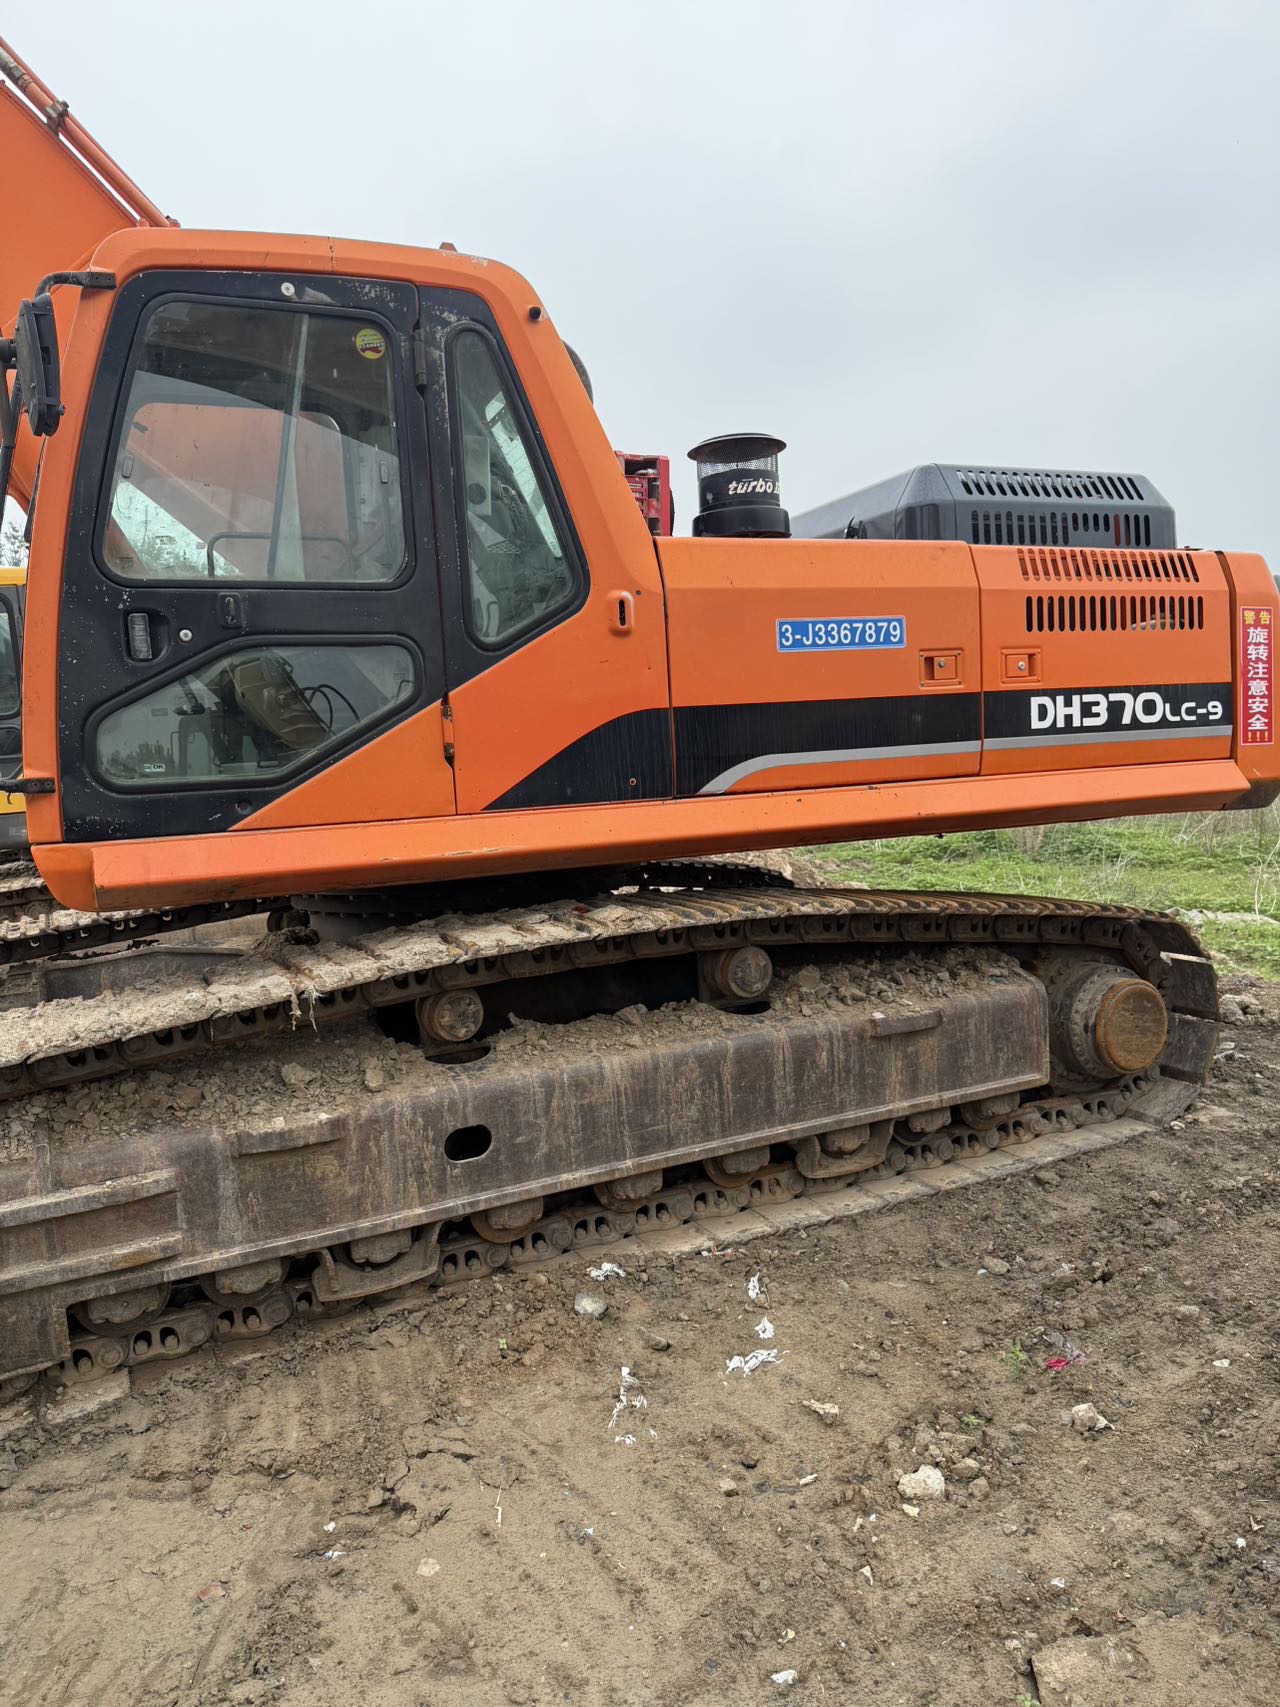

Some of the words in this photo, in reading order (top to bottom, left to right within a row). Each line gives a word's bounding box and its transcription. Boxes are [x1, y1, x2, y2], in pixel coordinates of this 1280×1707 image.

[728, 478, 773, 495] turbo
[1243, 610, 1271, 624] 警告
[781, 621, 901, 646] 3-J3367879
